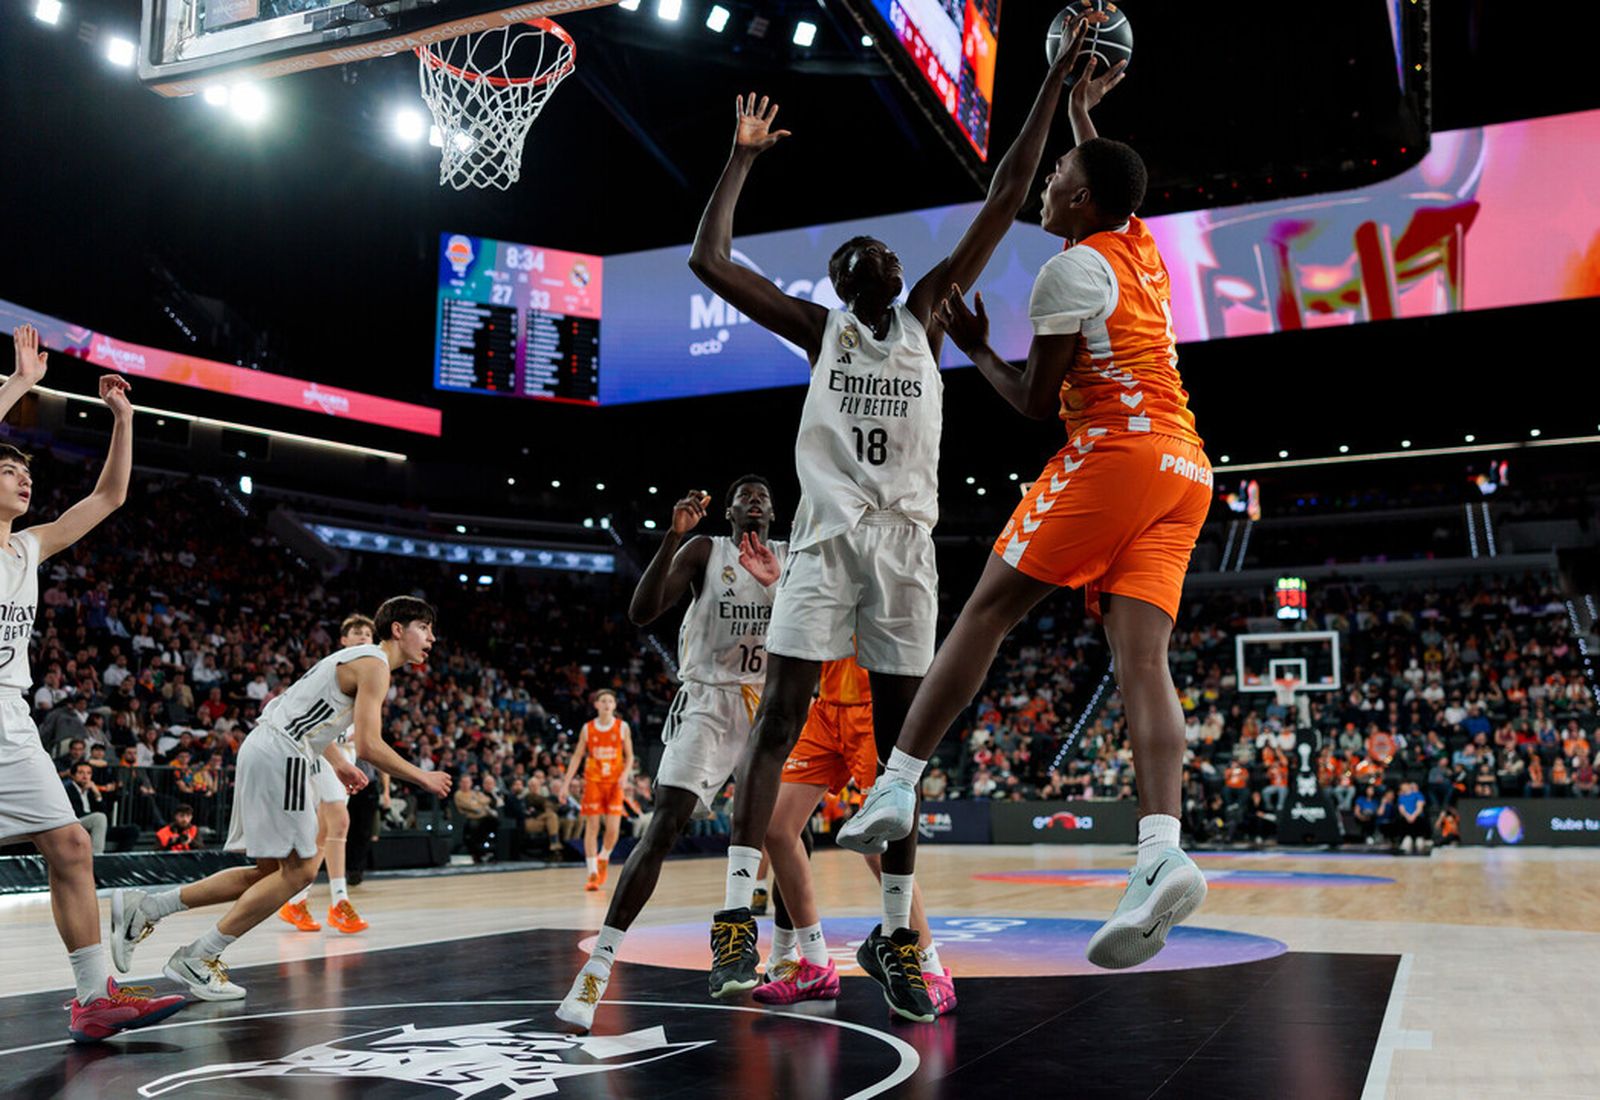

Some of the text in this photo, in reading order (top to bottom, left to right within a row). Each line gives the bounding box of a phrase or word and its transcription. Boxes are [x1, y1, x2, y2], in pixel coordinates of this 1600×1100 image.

[329, 37, 420, 62] MINICOPA
[506, 246, 545, 272] 8:34
[492, 284, 513, 305] 27
[829, 369, 922, 398] Emirates
[840, 396, 908, 418] FLY BETTER
[852, 426, 888, 466] 18
[719, 602, 773, 619] Emira
[730, 621, 749, 636] FLY
[740, 644, 764, 673] 16
[1551, 817, 1583, 830] Sube
